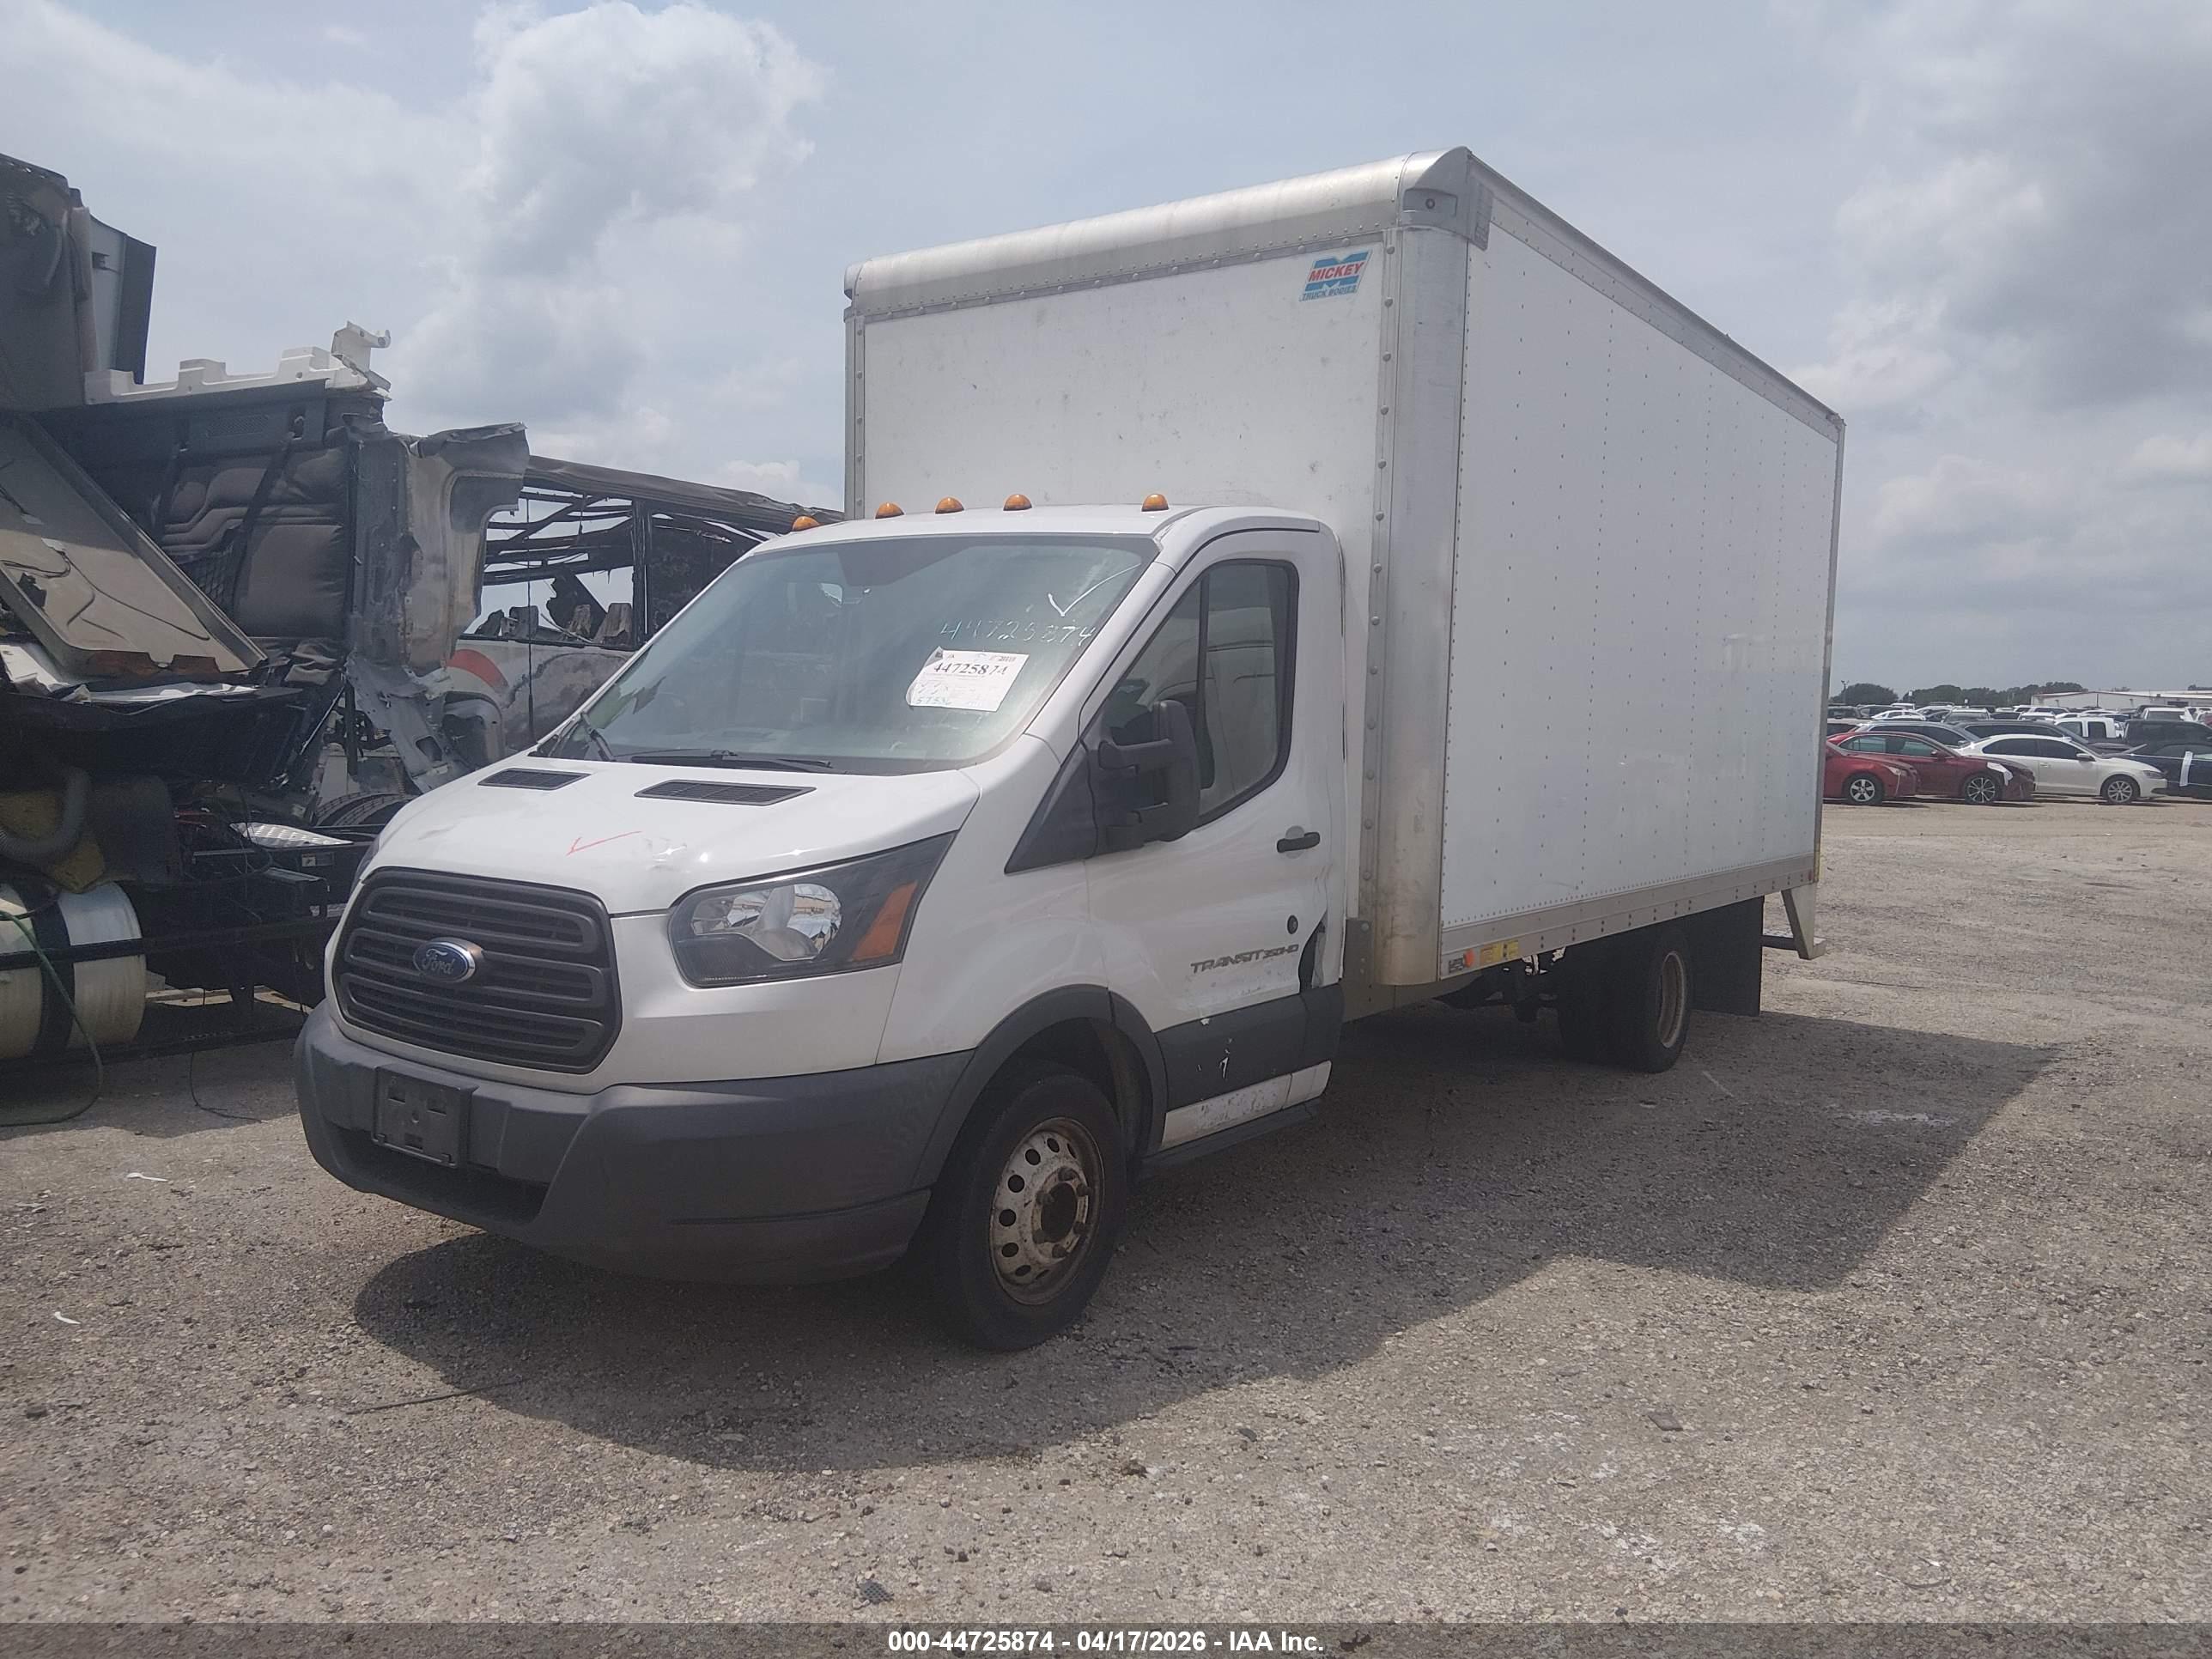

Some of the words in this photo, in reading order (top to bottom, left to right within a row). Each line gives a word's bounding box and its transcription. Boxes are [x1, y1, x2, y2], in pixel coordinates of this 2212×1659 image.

[1308, 261, 1365, 283] MICKEY
[934, 662, 1008, 675] 44725874
[1190, 949, 1265, 974] TRANSIT
